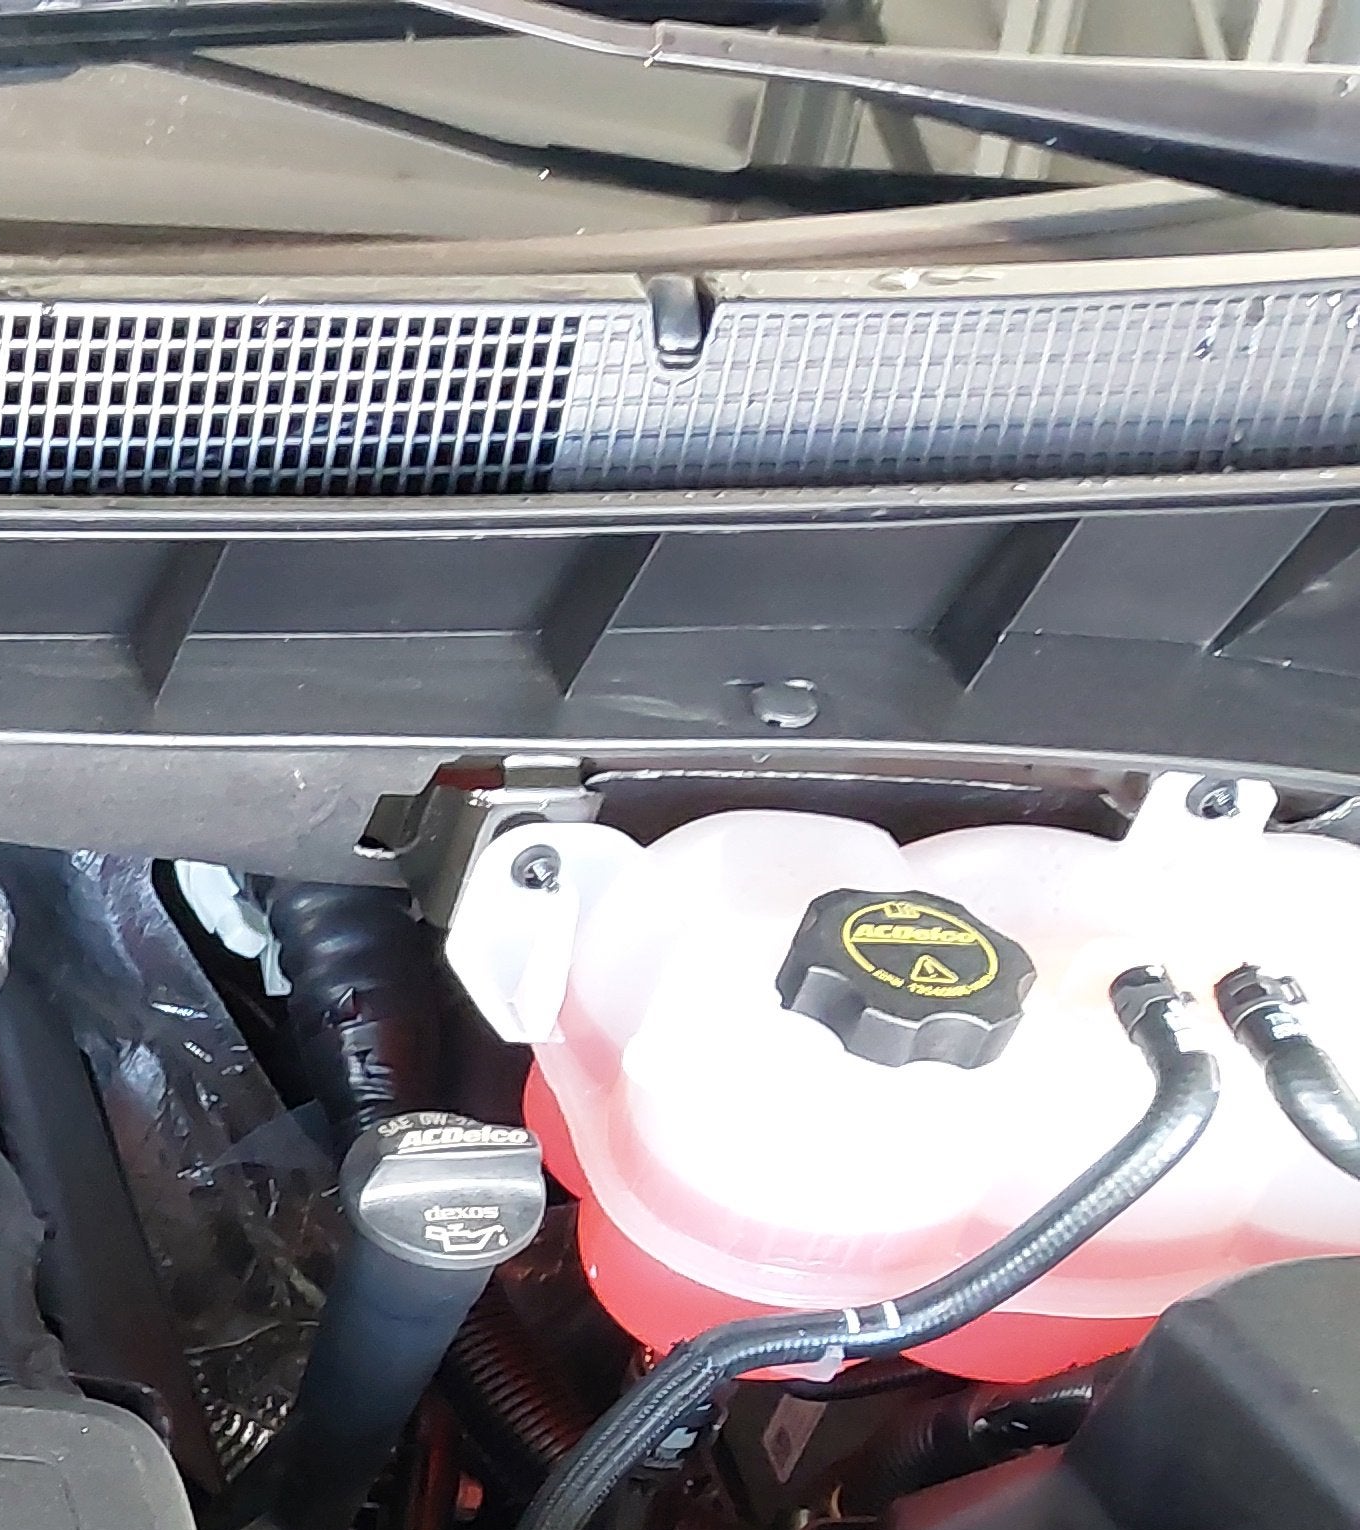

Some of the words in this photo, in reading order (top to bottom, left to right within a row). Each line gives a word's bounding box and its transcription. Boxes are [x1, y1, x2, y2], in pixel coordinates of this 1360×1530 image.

[851, 924, 978, 943] ACDelco
[378, 1115, 414, 1137] SAE
[397, 1126, 529, 1150] ACDelco
[423, 1205, 500, 1221] dexos
